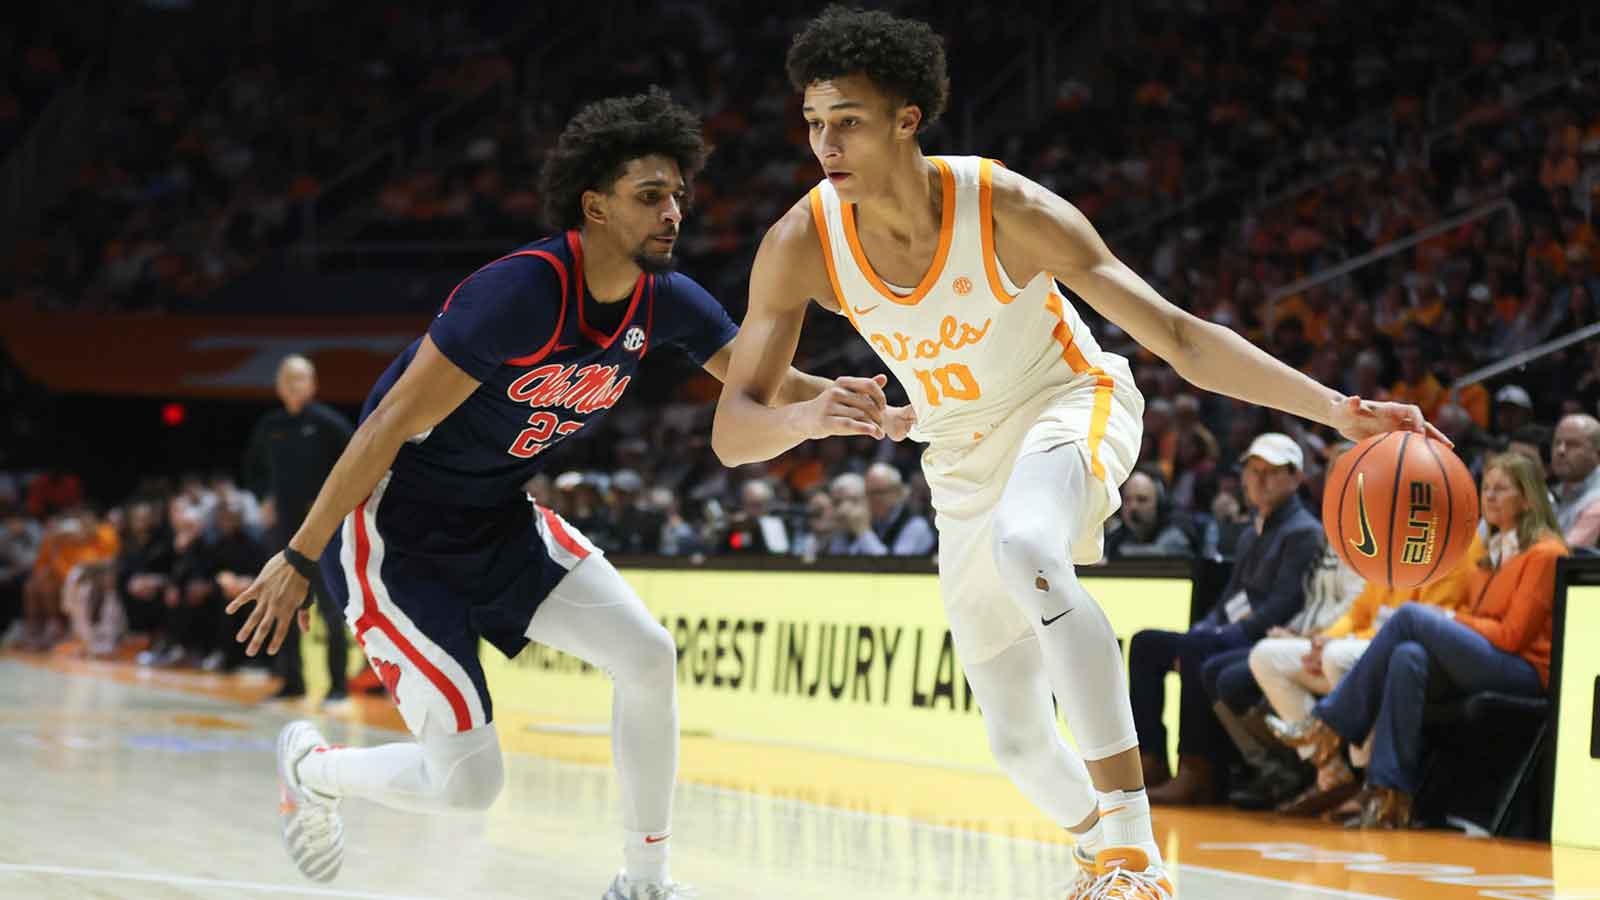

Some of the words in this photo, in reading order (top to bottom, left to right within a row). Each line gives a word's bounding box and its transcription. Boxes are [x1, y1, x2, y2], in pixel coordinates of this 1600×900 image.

[870, 315, 992, 361] Vols
[912, 363, 981, 407] 10
[1400, 480, 1432, 565] ELITE
[660, 617, 766, 693] RGEST
[772, 621, 903, 705] INJURY
